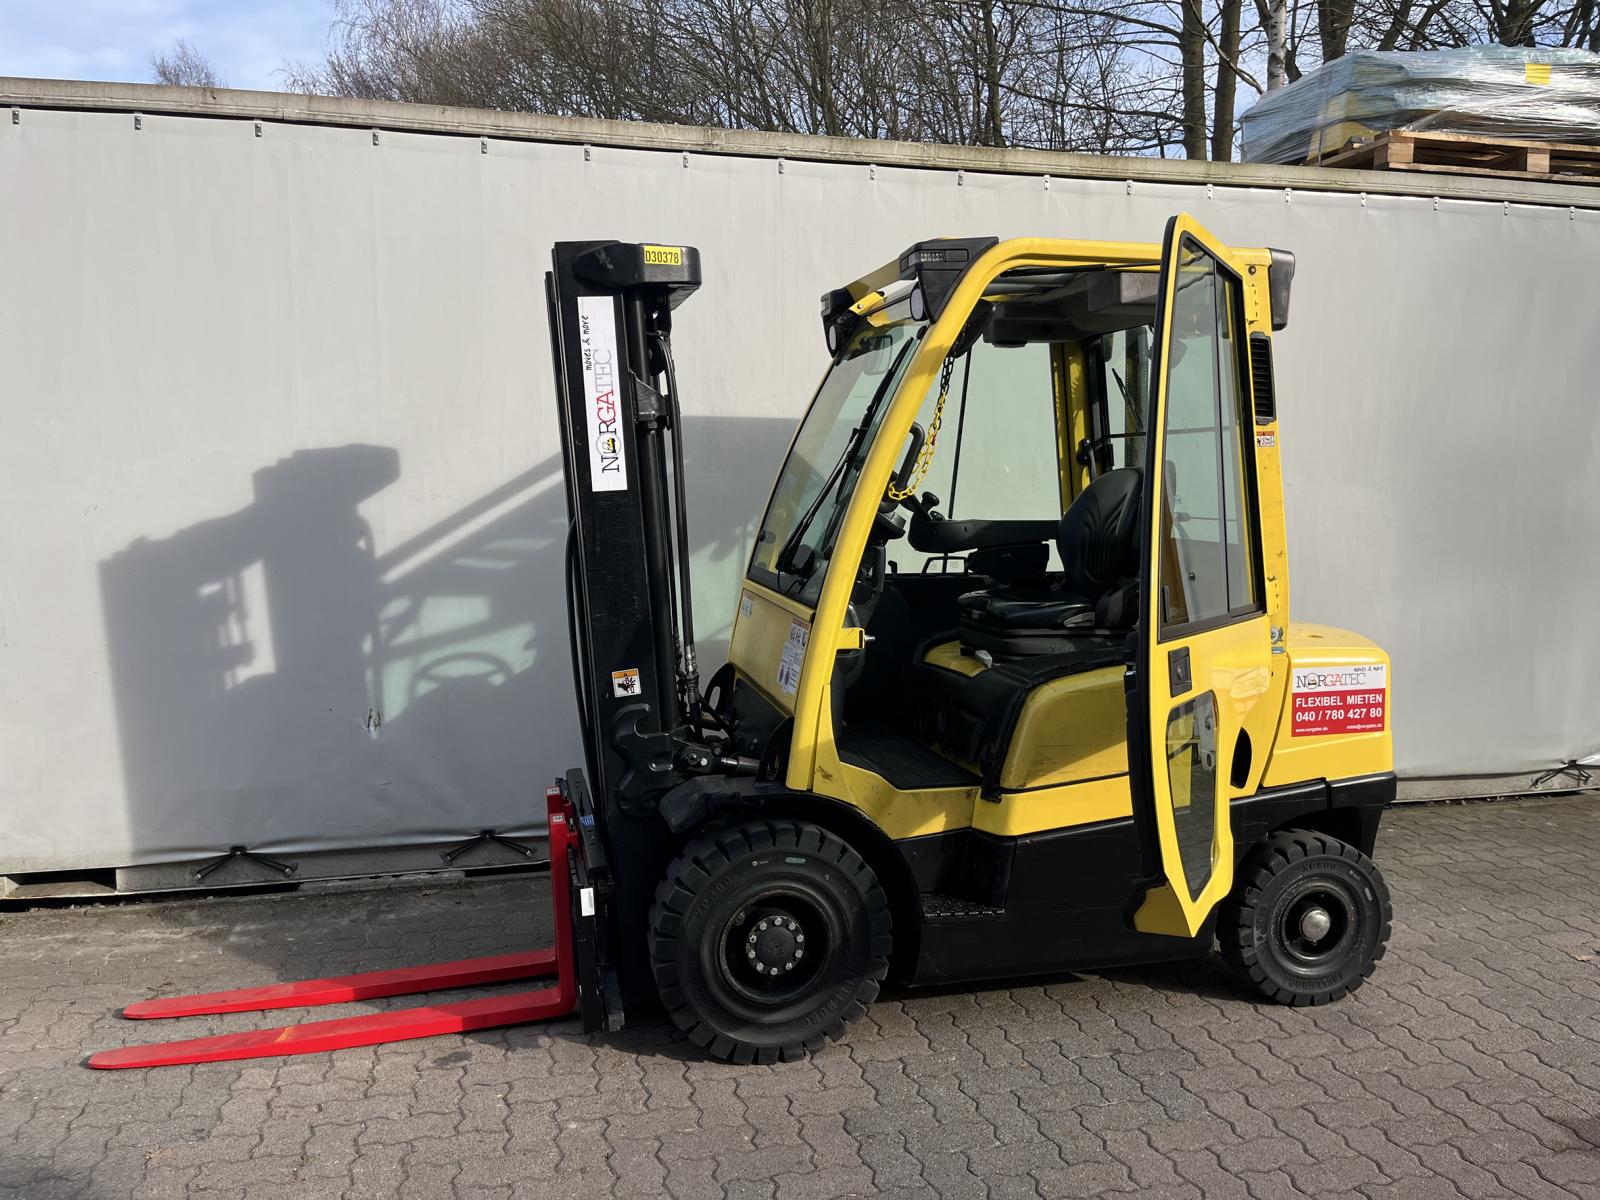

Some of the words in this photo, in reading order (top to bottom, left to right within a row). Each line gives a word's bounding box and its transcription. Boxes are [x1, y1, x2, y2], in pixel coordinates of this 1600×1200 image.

[646, 250, 679, 264] D30378
[581, 316, 590, 334] more
[582, 338, 590, 346] &
[584, 348, 592, 370] moves
[592, 349, 621, 474] NORGATEC
[1296, 672, 1366, 690] NORGATEC
[1296, 696, 1342, 708] FLEXIBEL
[1346, 694, 1382, 705] MIETEN
[1296, 712, 1315, 722] 040
[1318, 711, 1322, 720] /
[1325, 710, 1344, 720] 780
[1348, 708, 1366, 718] 427
[1370, 708, 1382, 718] 80
